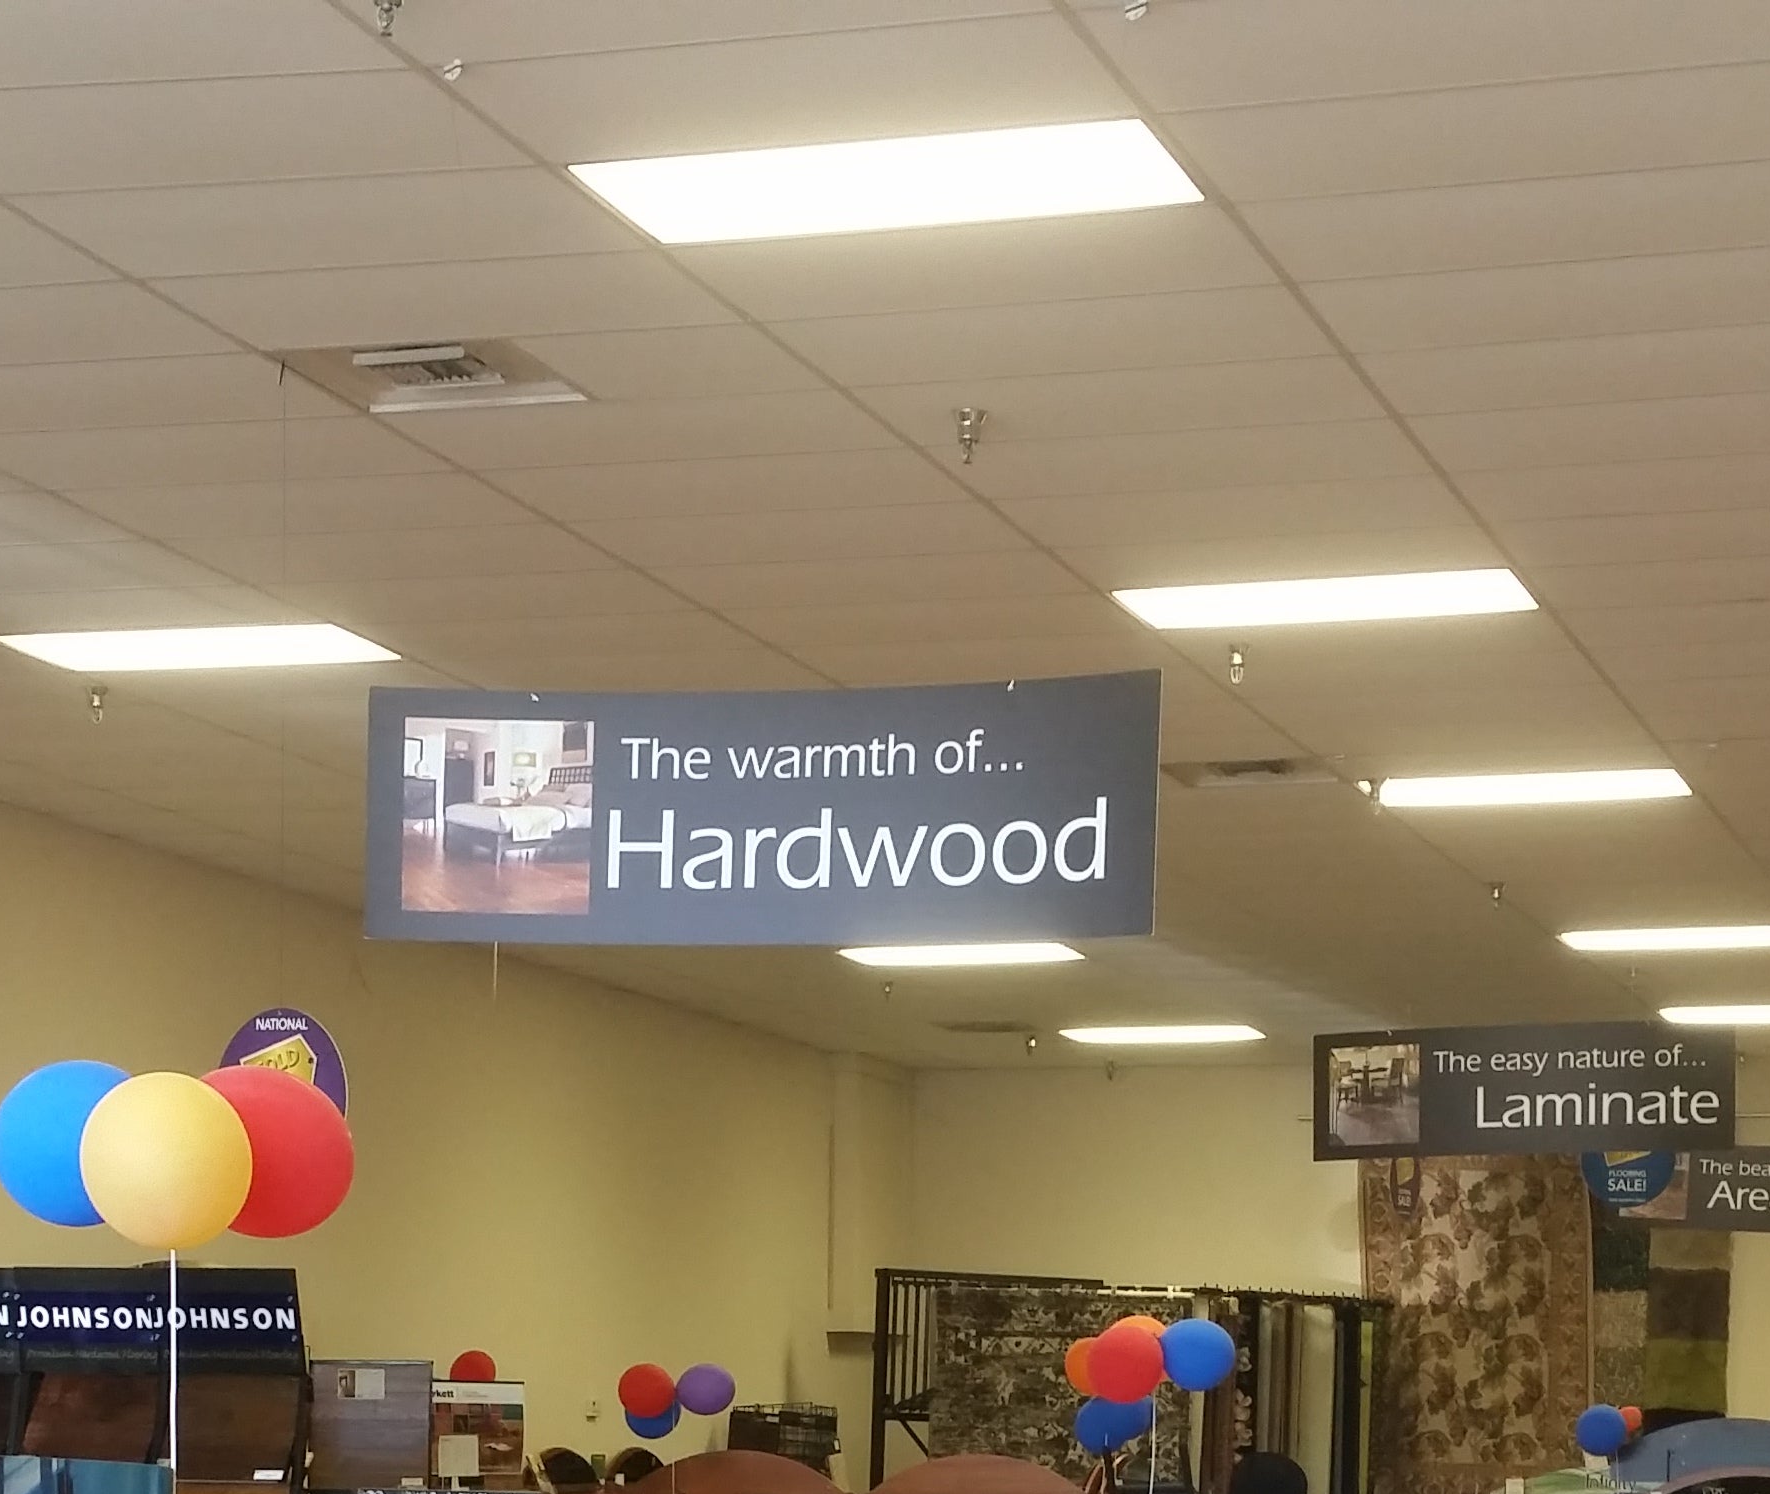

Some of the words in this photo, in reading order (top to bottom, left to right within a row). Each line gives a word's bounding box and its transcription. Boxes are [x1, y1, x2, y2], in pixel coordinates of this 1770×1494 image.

[621, 737, 712, 782] The
[727, 733, 917, 780] warmth
[934, 728, 1026, 775] of...
[607, 796, 1111, 891] Hardwood
[255, 1017, 309, 1031] NATIONAL
[258, 1049, 300, 1070] OLD
[1433, 1049, 1481, 1074] The
[1490, 1051, 1549, 1078] easy
[1557, 1047, 1645, 1070] nature
[1653, 1043, 1708, 1068] of...
[1475, 1083, 1720, 1130] Laminate
[1699, 1158, 1733, 1176] The
[1607, 1178, 1647, 1193] SALE!
[17, 1305, 154, 1330] JOHNSON
[153, 1306, 296, 1330] JOHNSON
